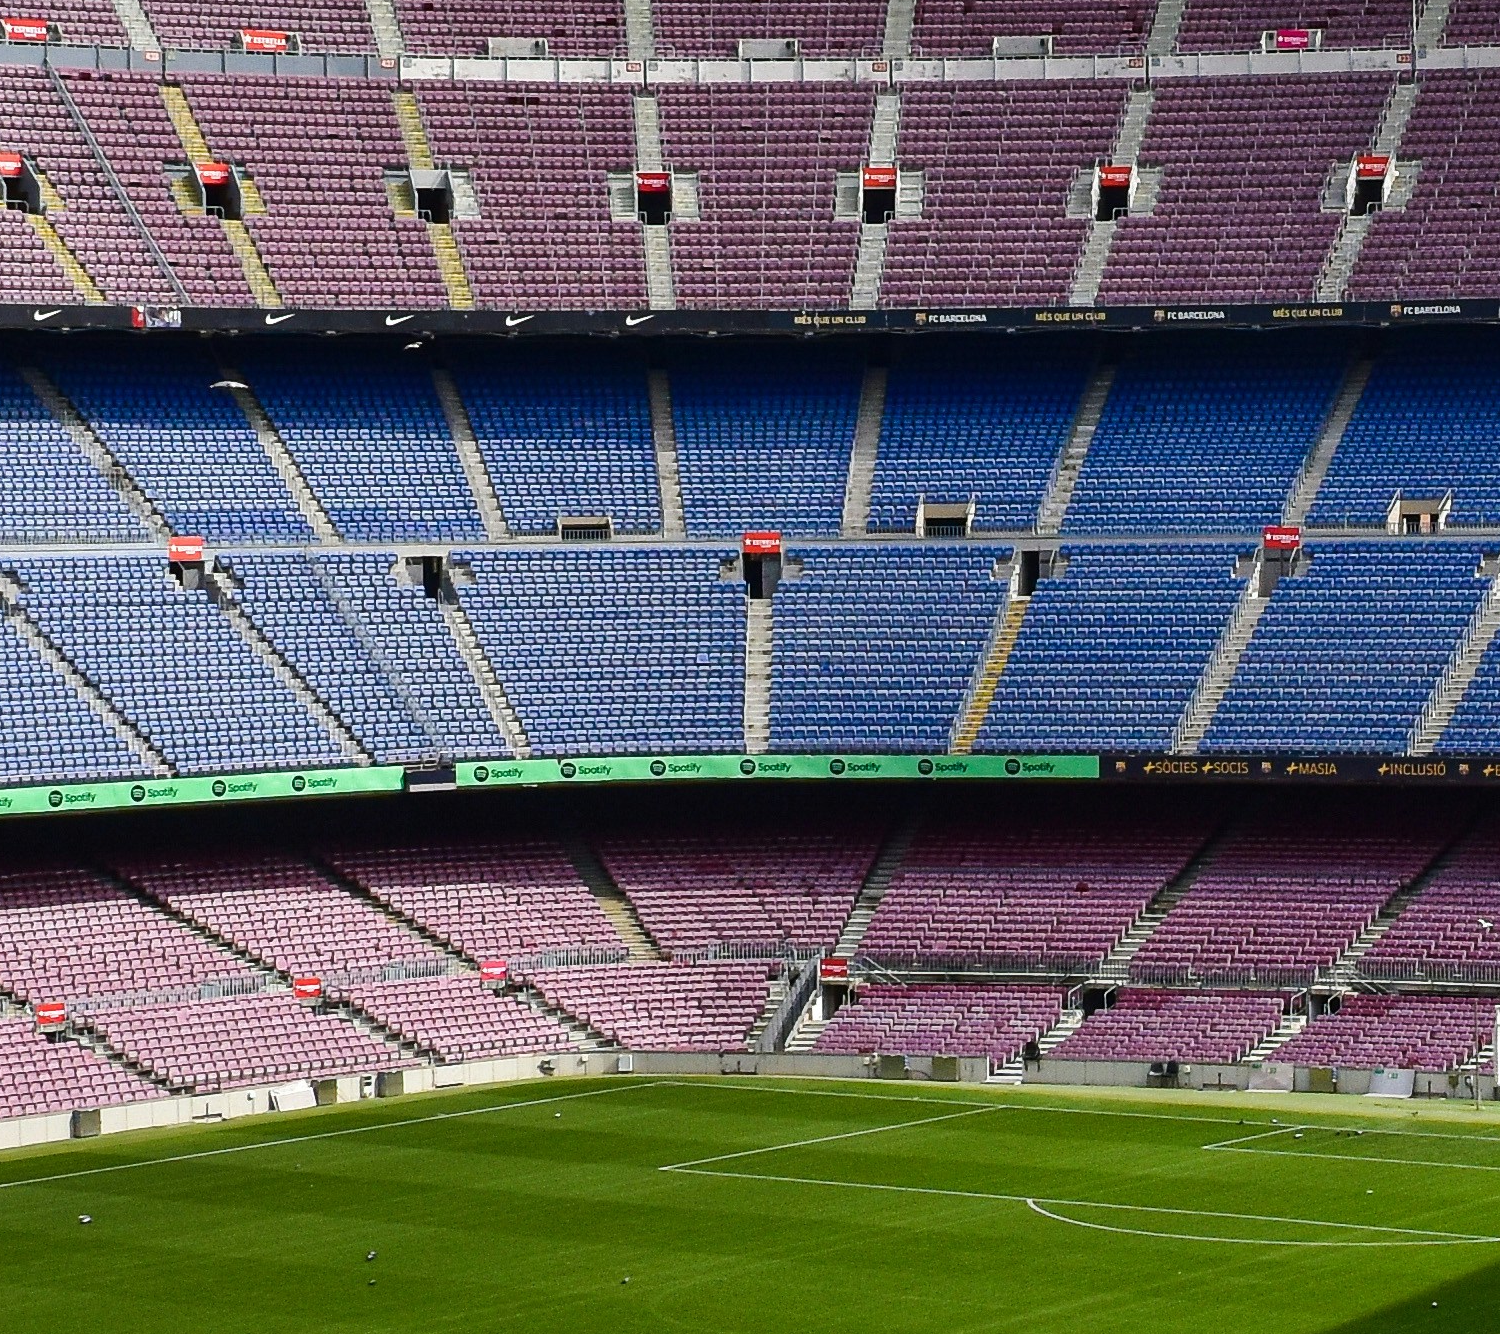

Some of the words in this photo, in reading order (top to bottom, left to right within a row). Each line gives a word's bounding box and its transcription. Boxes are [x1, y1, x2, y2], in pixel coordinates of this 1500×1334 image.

[1167, 311, 1177, 320] FC
[1178, 310, 1225, 319] BARCELONA
[1322, 307, 1343, 317] CLUB
[1403, 305, 1413, 315] FC
[1414, 304, 1461, 315] BARCELONA
[845, 315, 866, 324] CLUB
[928, 314, 938, 323] FC
[939, 313, 987, 323] BARCELONA
[1053, 312, 1070, 322] QUE
[1085, 311, 1106, 320] CLUB
[491, 766, 523, 780] Spotify
[578, 763, 612, 777] Spotify
[668, 761, 702, 775] Spotify
[758, 760, 792, 774] Spotify
[847, 760, 882, 773] Spotify
[934, 760, 969, 773] Spotify
[1022, 760, 1055, 773] Spotify
[228, 780, 259, 794] Spotify
[307, 776, 338, 789] Spotify
[64, 790, 97, 804] Spotify
[147, 785, 179, 799] Spotify
